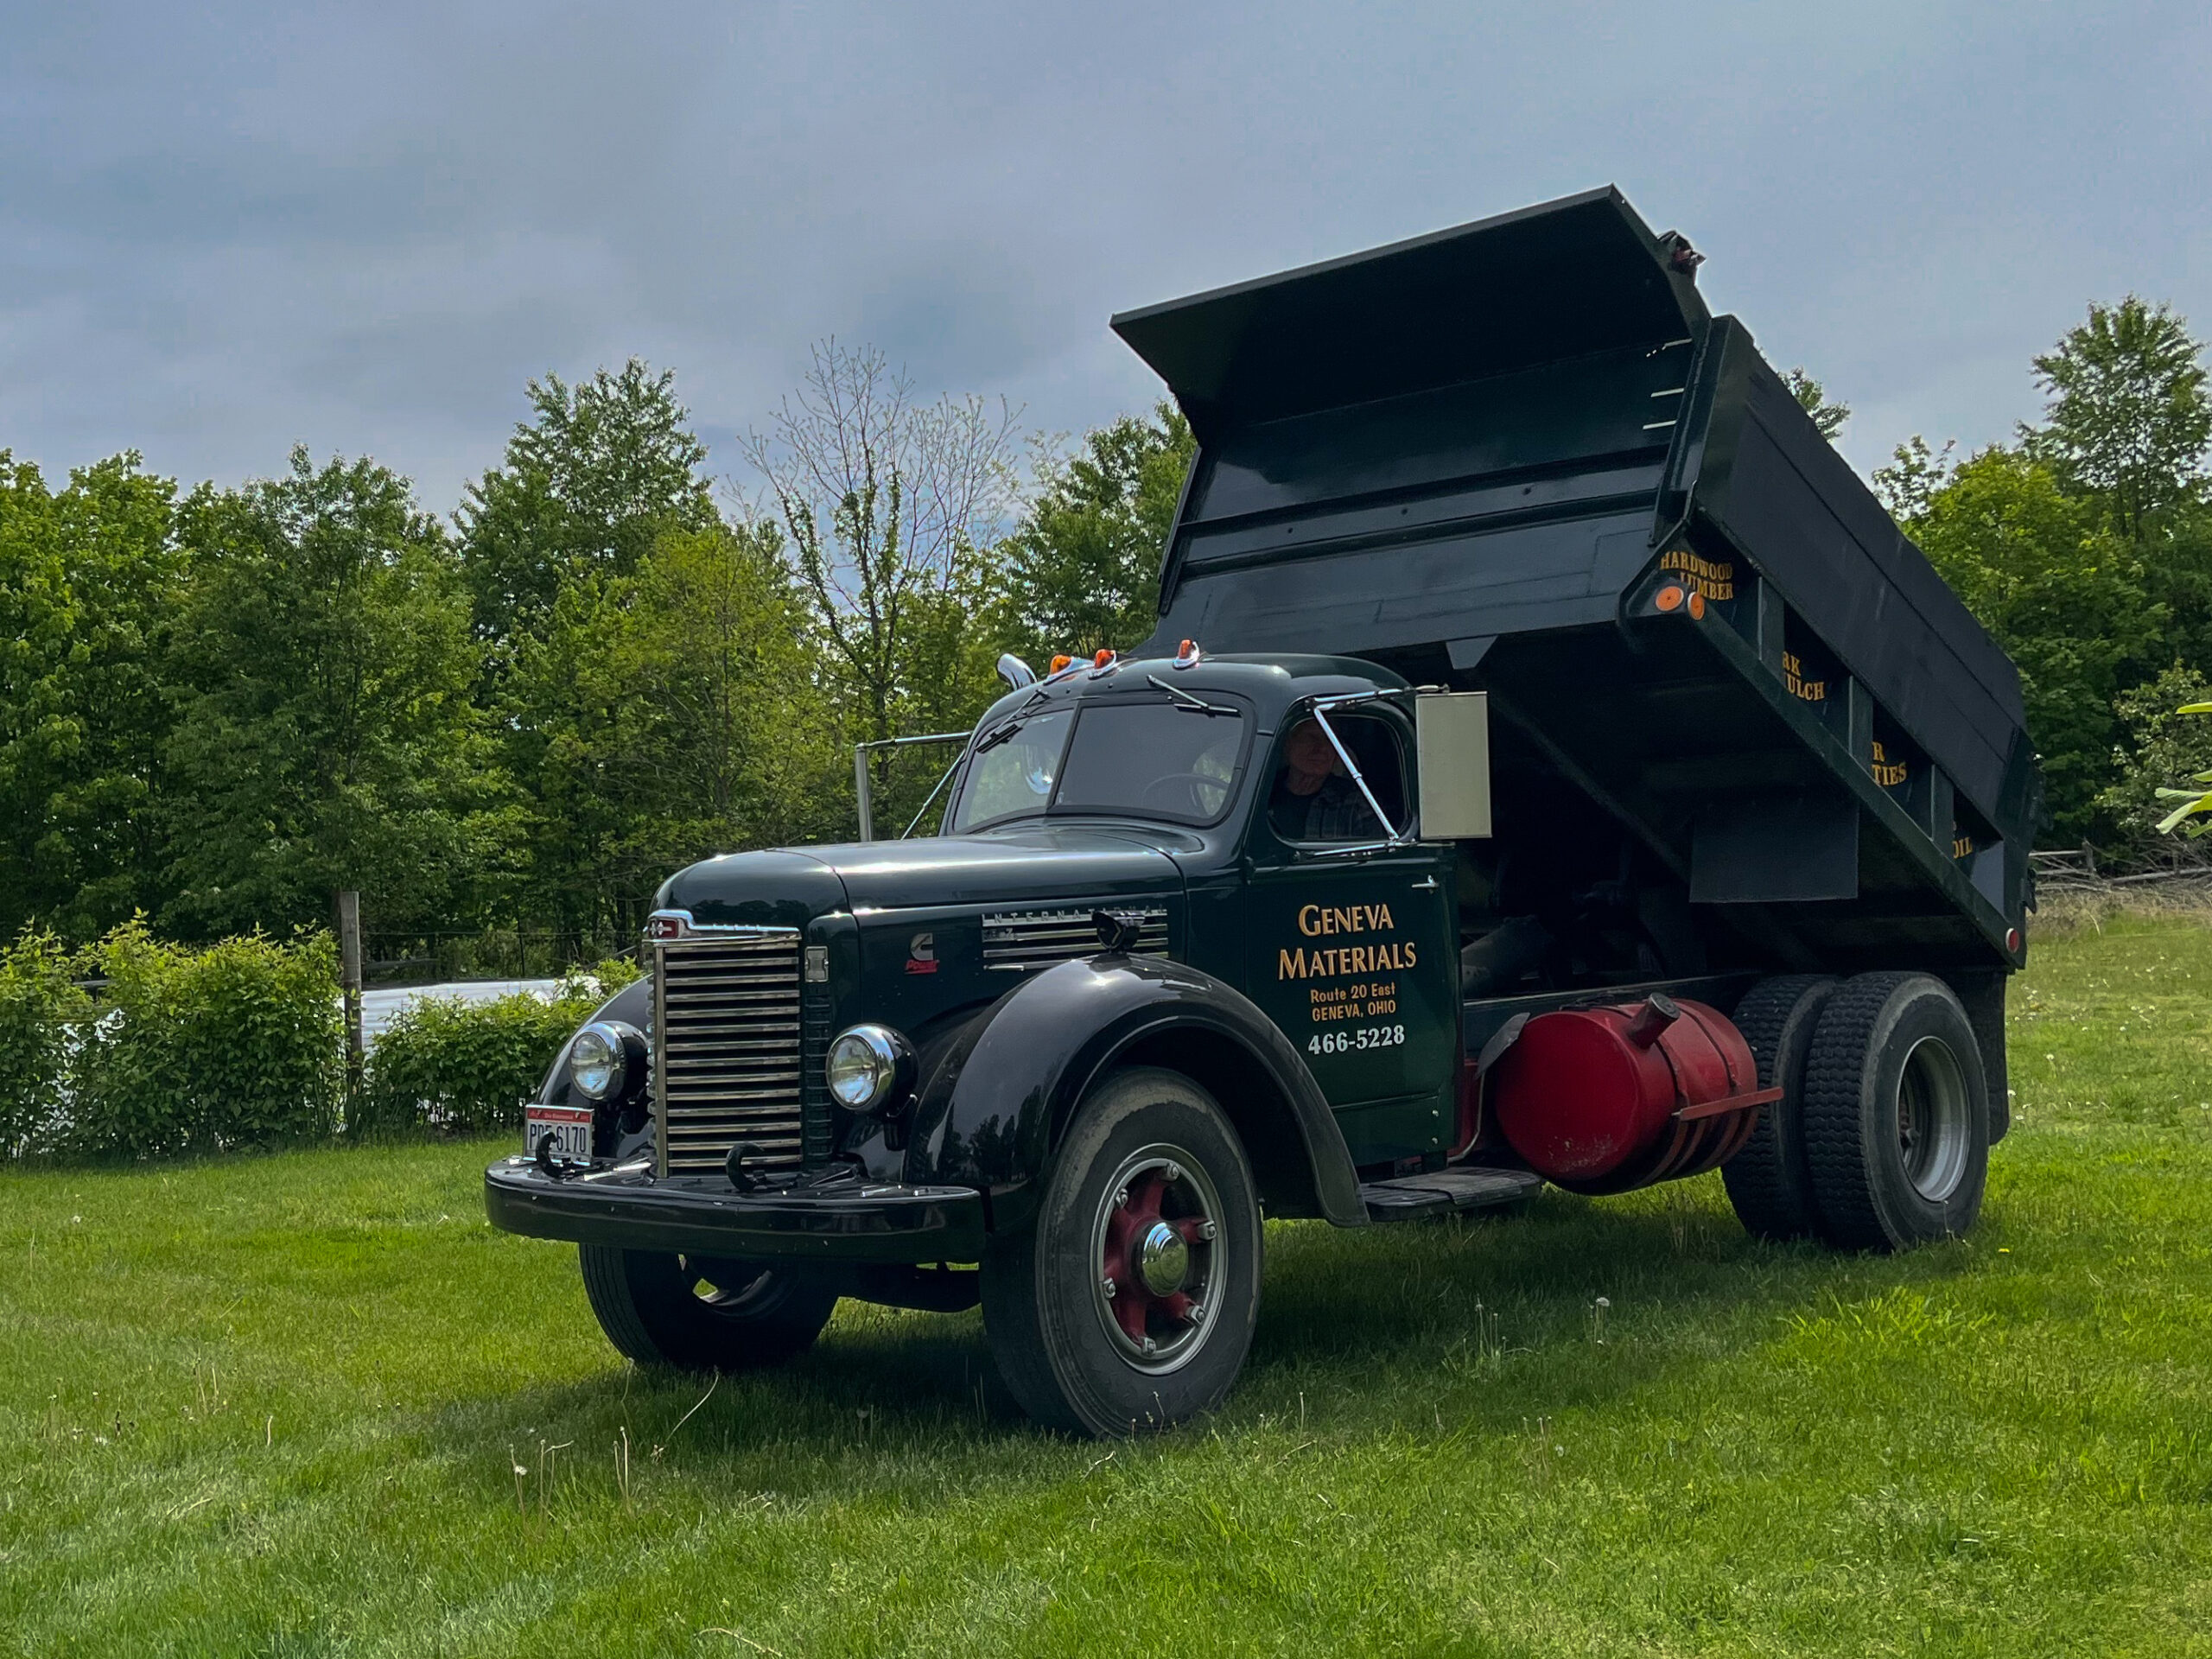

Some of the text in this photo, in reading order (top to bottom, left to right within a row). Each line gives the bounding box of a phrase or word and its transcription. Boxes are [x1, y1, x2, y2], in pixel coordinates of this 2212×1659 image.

[1661, 551, 1732, 581] HARDWOOD
[1783, 672, 1825, 701] ULCH
[982, 904, 1166, 925] INTERNATAL
[1298, 904, 1395, 937] GENEVA
[1278, 942, 1417, 981] MATERIALS
[1310, 982, 1395, 1003] Route 20 East
[1312, 1000, 1396, 1021] GENEVA, OHIO
[1307, 1024, 1406, 1055] 466-5228
[556, 1126, 587, 1153] 6170
